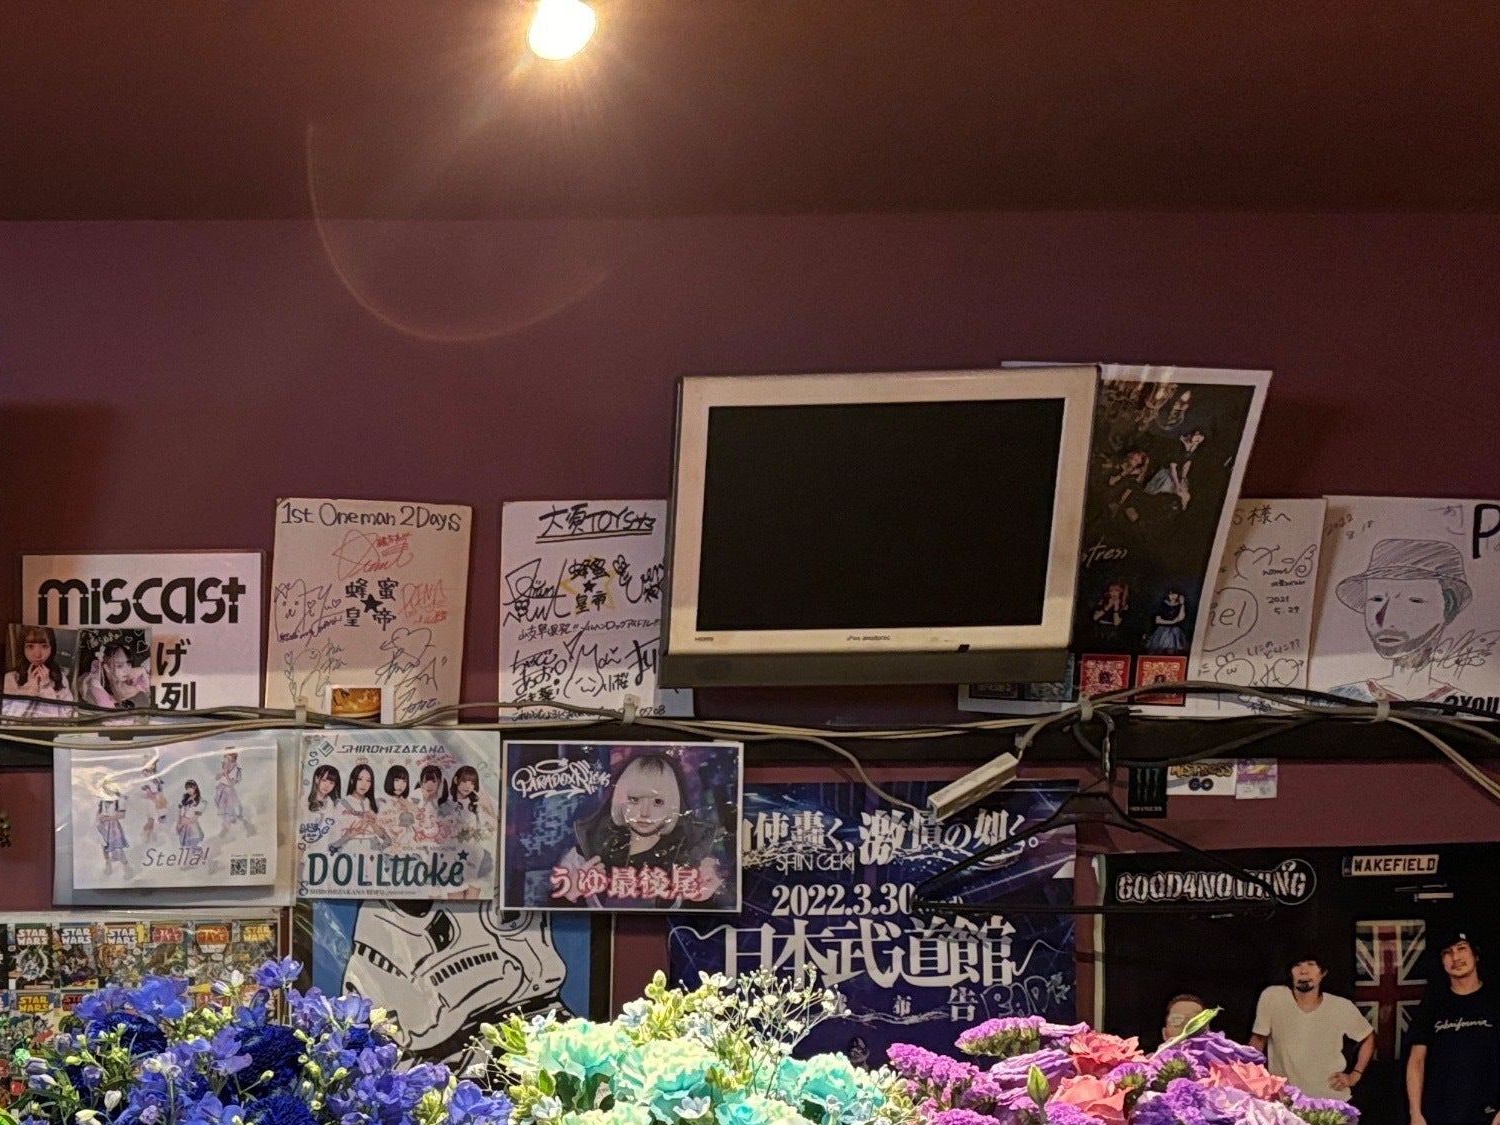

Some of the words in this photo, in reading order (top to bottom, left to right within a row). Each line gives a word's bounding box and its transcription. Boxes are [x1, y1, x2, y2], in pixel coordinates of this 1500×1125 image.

[281, 502, 314, 524] 1st
[38, 577, 246, 625] miscast
[142, 848, 210, 867] Stella!
[1354, 857, 1436, 872] WAKEFIELD
[771, 882, 917, 916] 2022.3.30
[17, 928, 48, 937] STAR
[61, 928, 91, 936] STAR
[107, 928, 137, 936] STAR
[16, 937, 48, 946] WARS
[61, 936, 92, 944] WARS
[107, 936, 138, 944] WARS
[724, 915, 1017, 990] 日本武道館
[18, 996, 49, 1004] STAR
[18, 1004, 50, 1013] WARS
